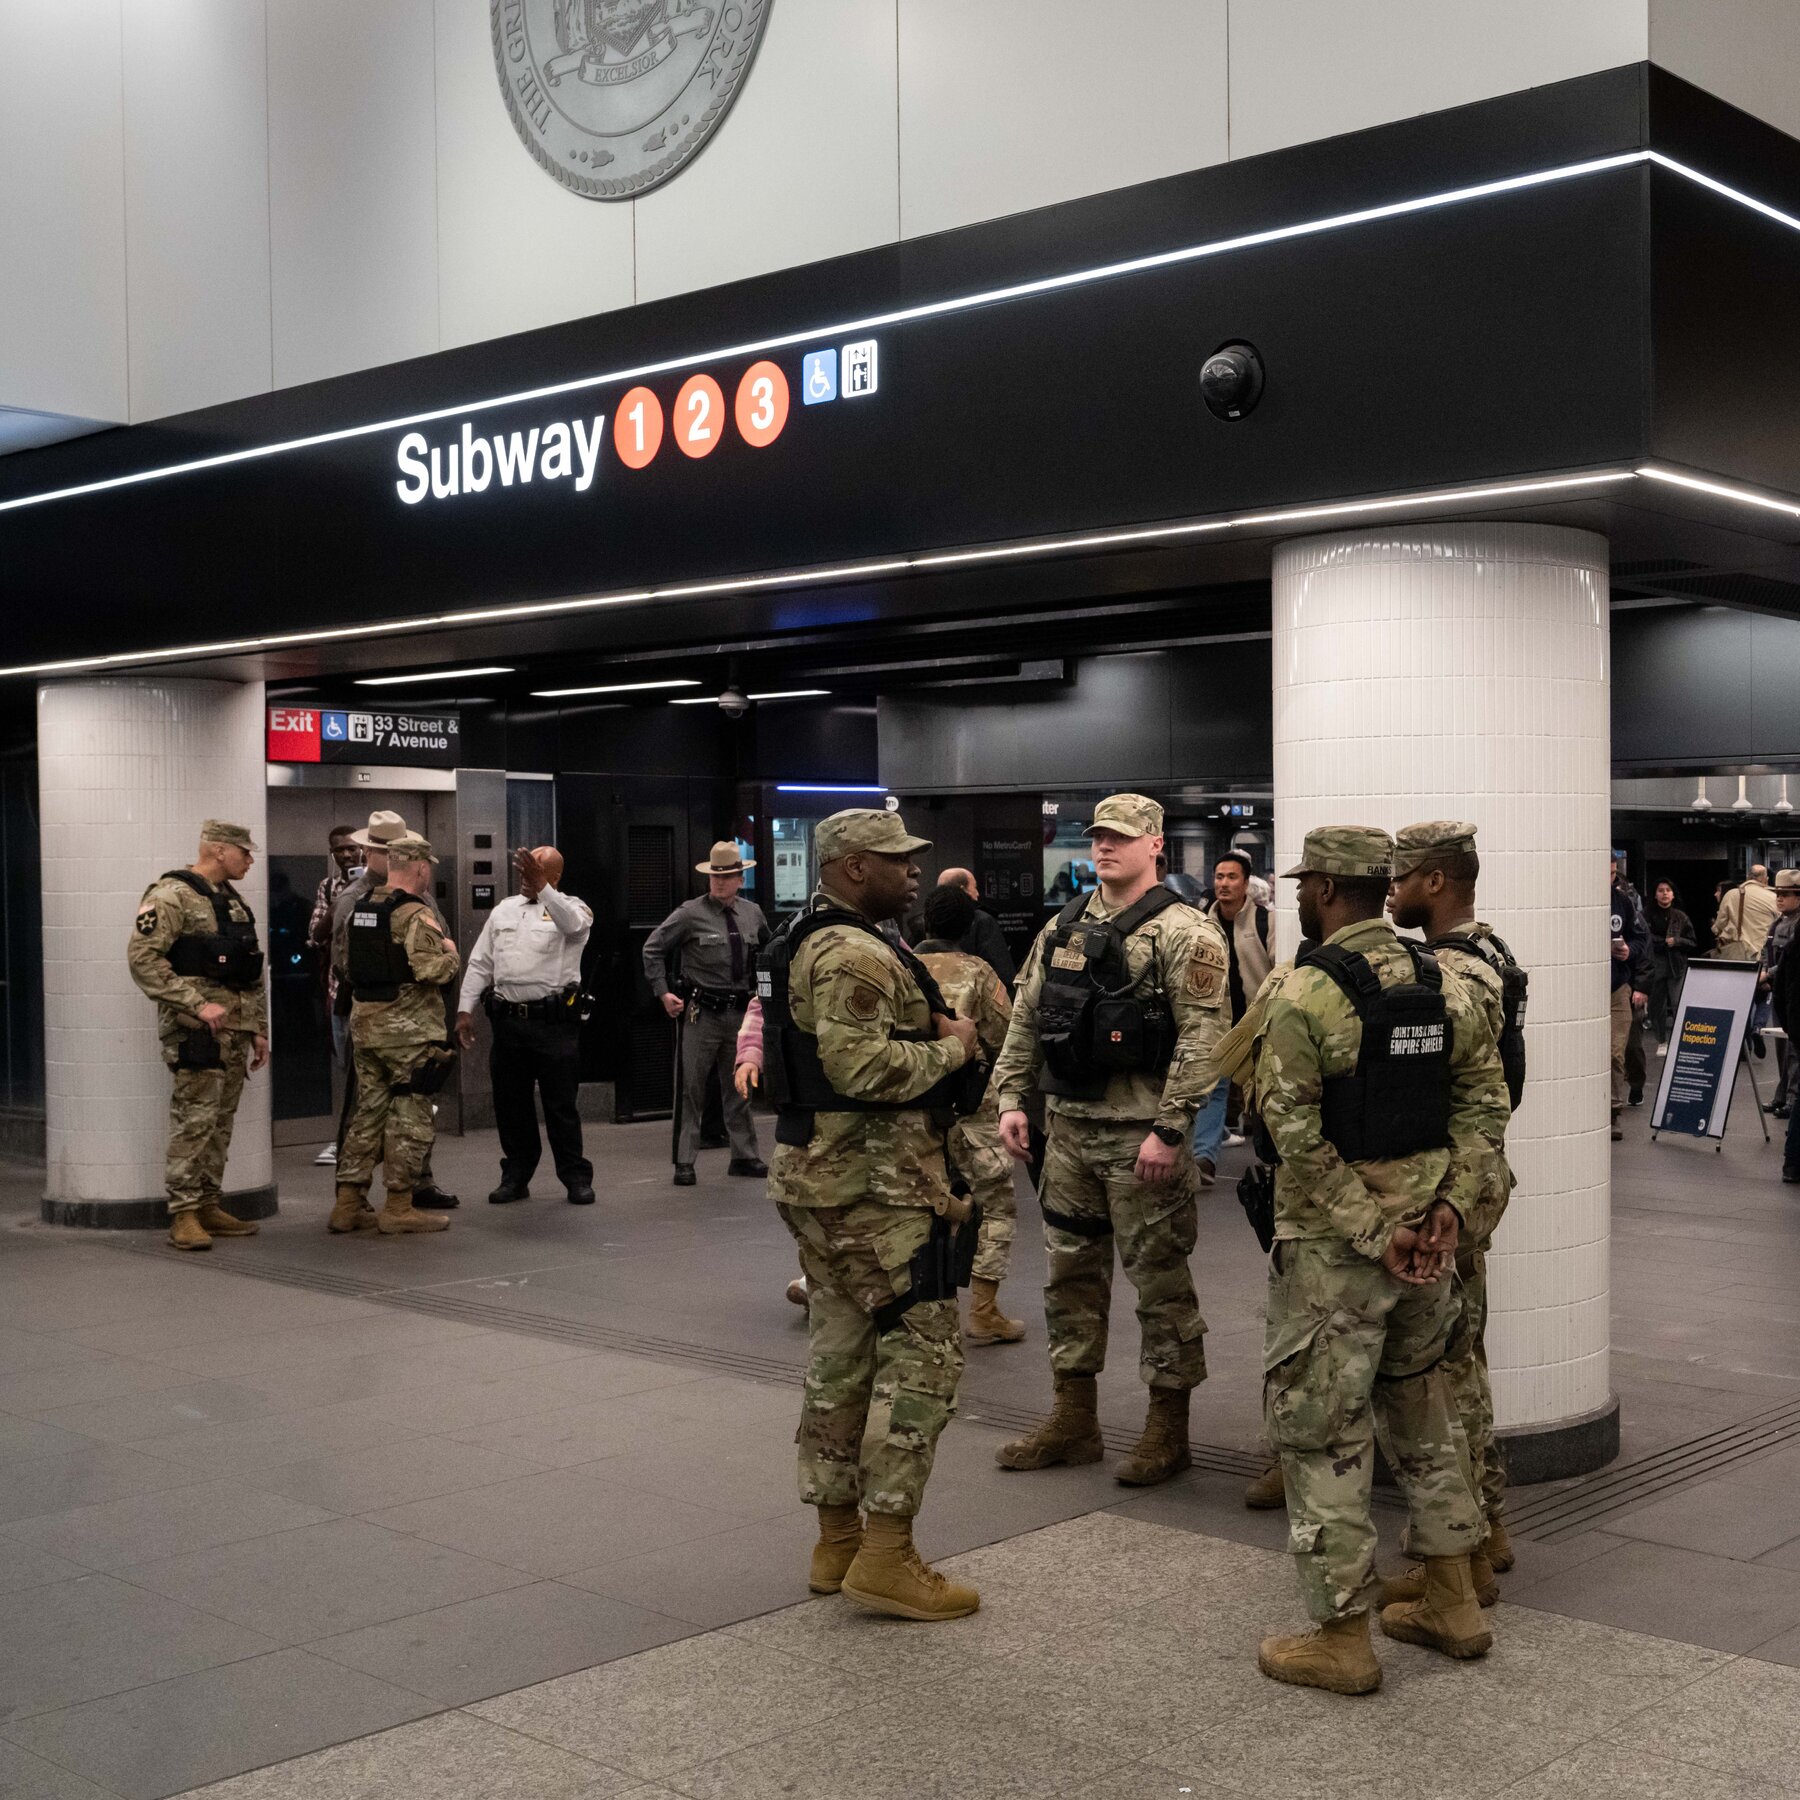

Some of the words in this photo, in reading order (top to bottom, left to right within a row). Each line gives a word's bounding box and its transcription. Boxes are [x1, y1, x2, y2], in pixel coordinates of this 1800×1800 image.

[698, 0, 746, 90] ORK
[595, 51, 660, 82] EXCELSIOR
[517, 66, 552, 135] THE
[396, 414, 605, 505] Subway
[628, 402, 645, 451] 1
[688, 390, 711, 442] 2
[751, 377, 775, 430] 3
[271, 710, 314, 733] Exit
[374, 715, 393, 731] 33
[398, 717, 443, 734] Street
[448, 720, 459, 735] &
[374, 731, 385, 747] 7
[389, 733, 448, 749] Avenue
[1391, 1026, 1410, 1038] JOINT
[1411, 1025, 1428, 1037] TASK
[1427, 1023, 1444, 1036] FORCE
[1684, 1021, 1717, 1033] Container
[1390, 1038, 1420, 1055] EMPIRE
[1420, 1036, 1444, 1054] SHIELD
[1682, 1032, 1716, 1045] Inspection
